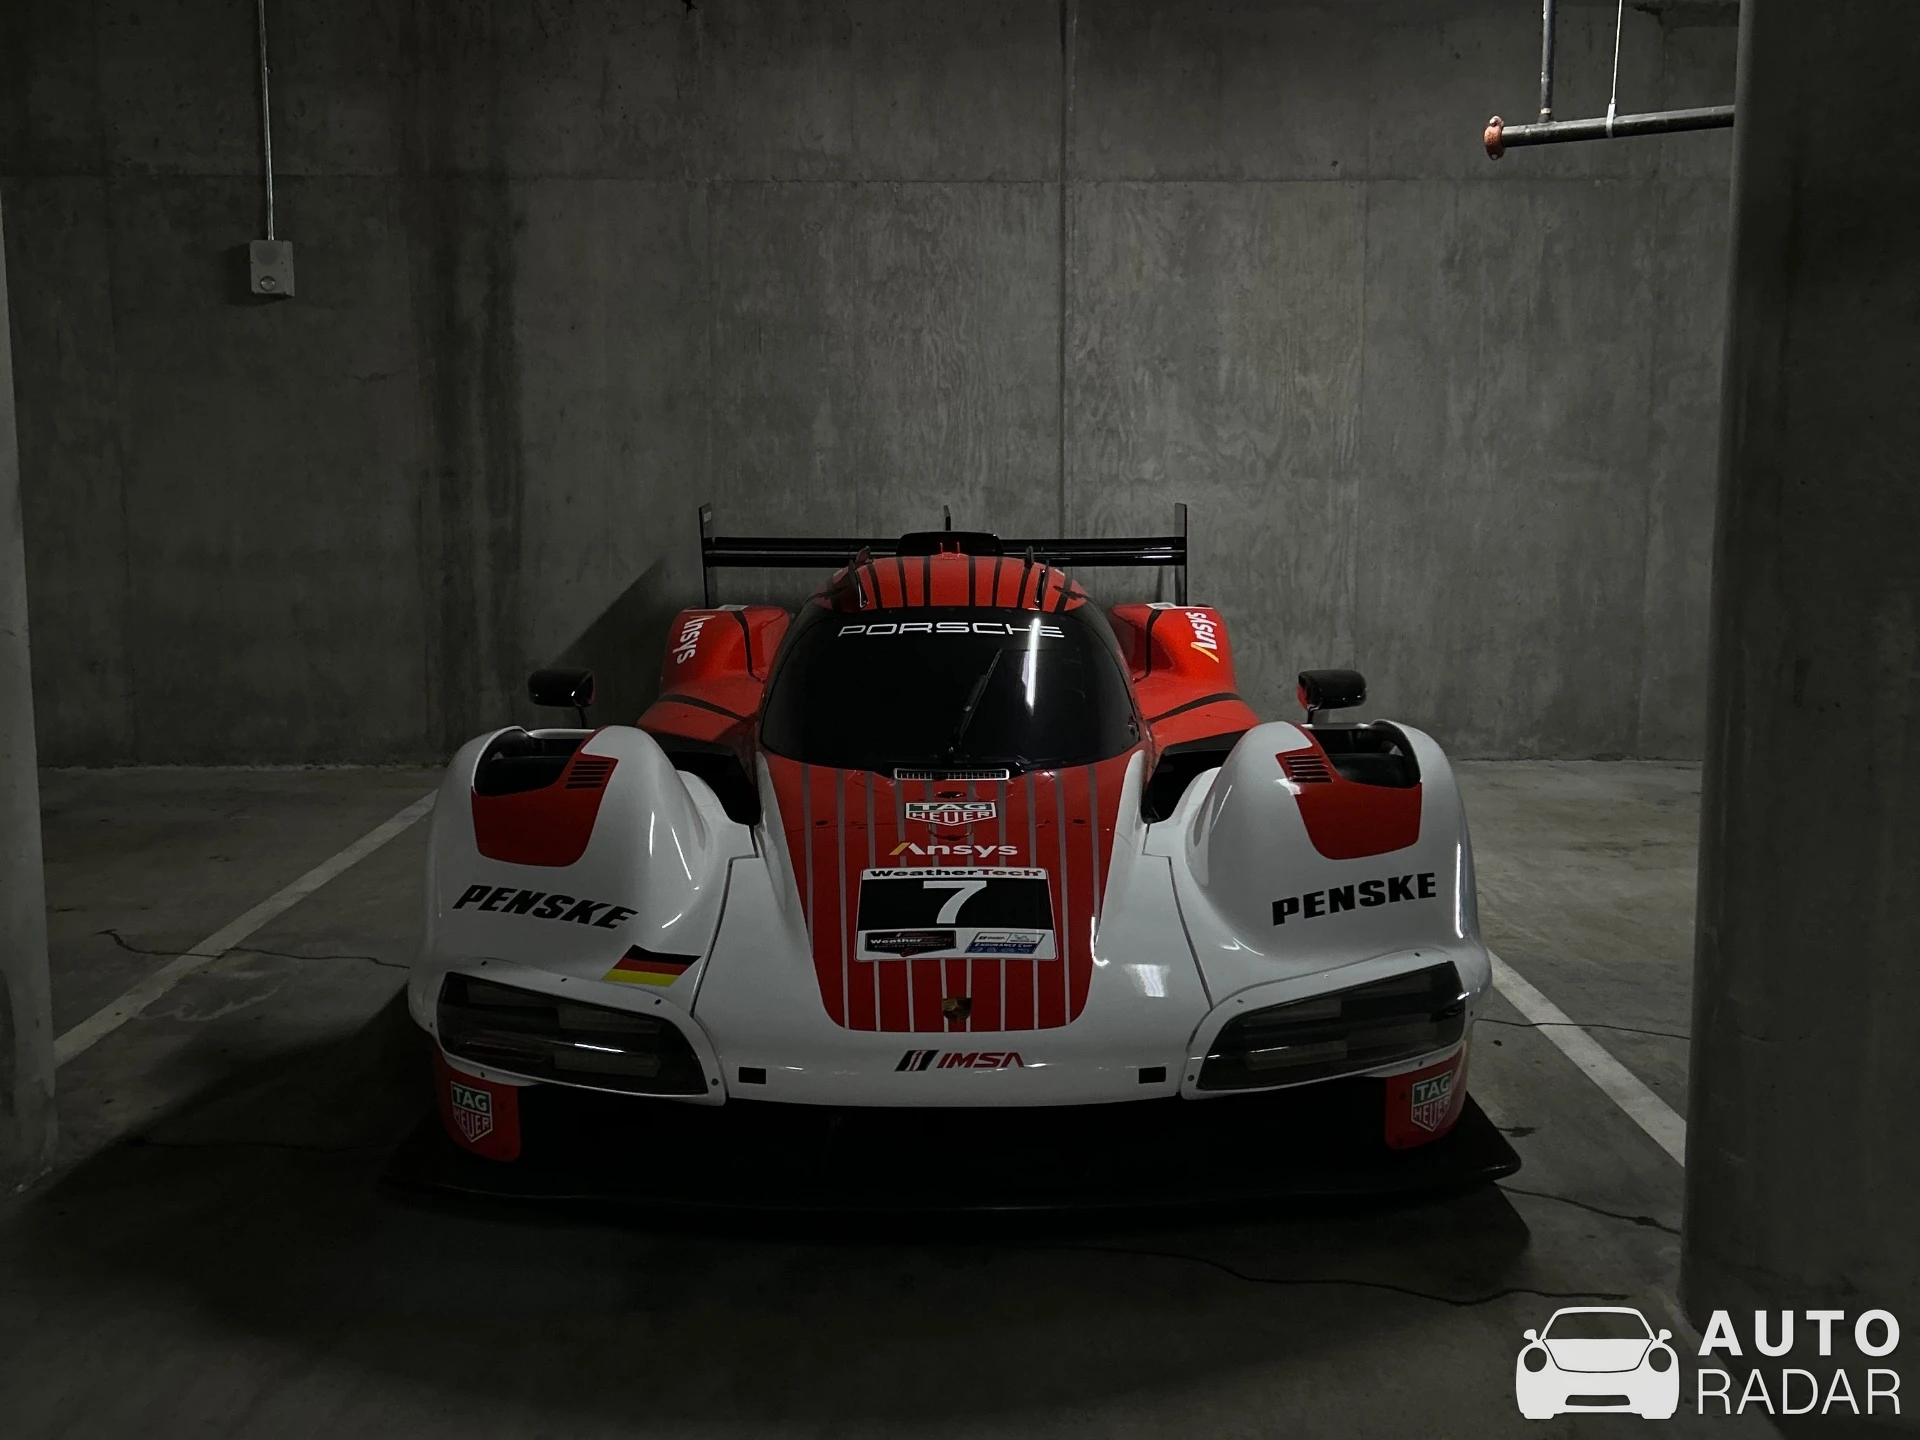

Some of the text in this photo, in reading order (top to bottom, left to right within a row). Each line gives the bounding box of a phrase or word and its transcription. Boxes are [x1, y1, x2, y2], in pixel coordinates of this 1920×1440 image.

[672, 614, 716, 665] Ansys
[837, 621, 1065, 638] PORSCHE
[1185, 611, 1220, 664] Ansys
[911, 811, 991, 823] HEUER
[913, 803, 987, 811] TAG
[888, 842, 1018, 858] Ansys
[452, 884, 638, 929] PENSKE
[923, 880, 987, 924] 7
[1272, 872, 1436, 926] PENSKE
[937, 1052, 1025, 1068] IMSA
[453, 1086, 488, 1111] TAG
[1416, 1076, 1449, 1100] TAG
[453, 1107, 490, 1138] HEUER
[1414, 1096, 1450, 1126] HEUER
